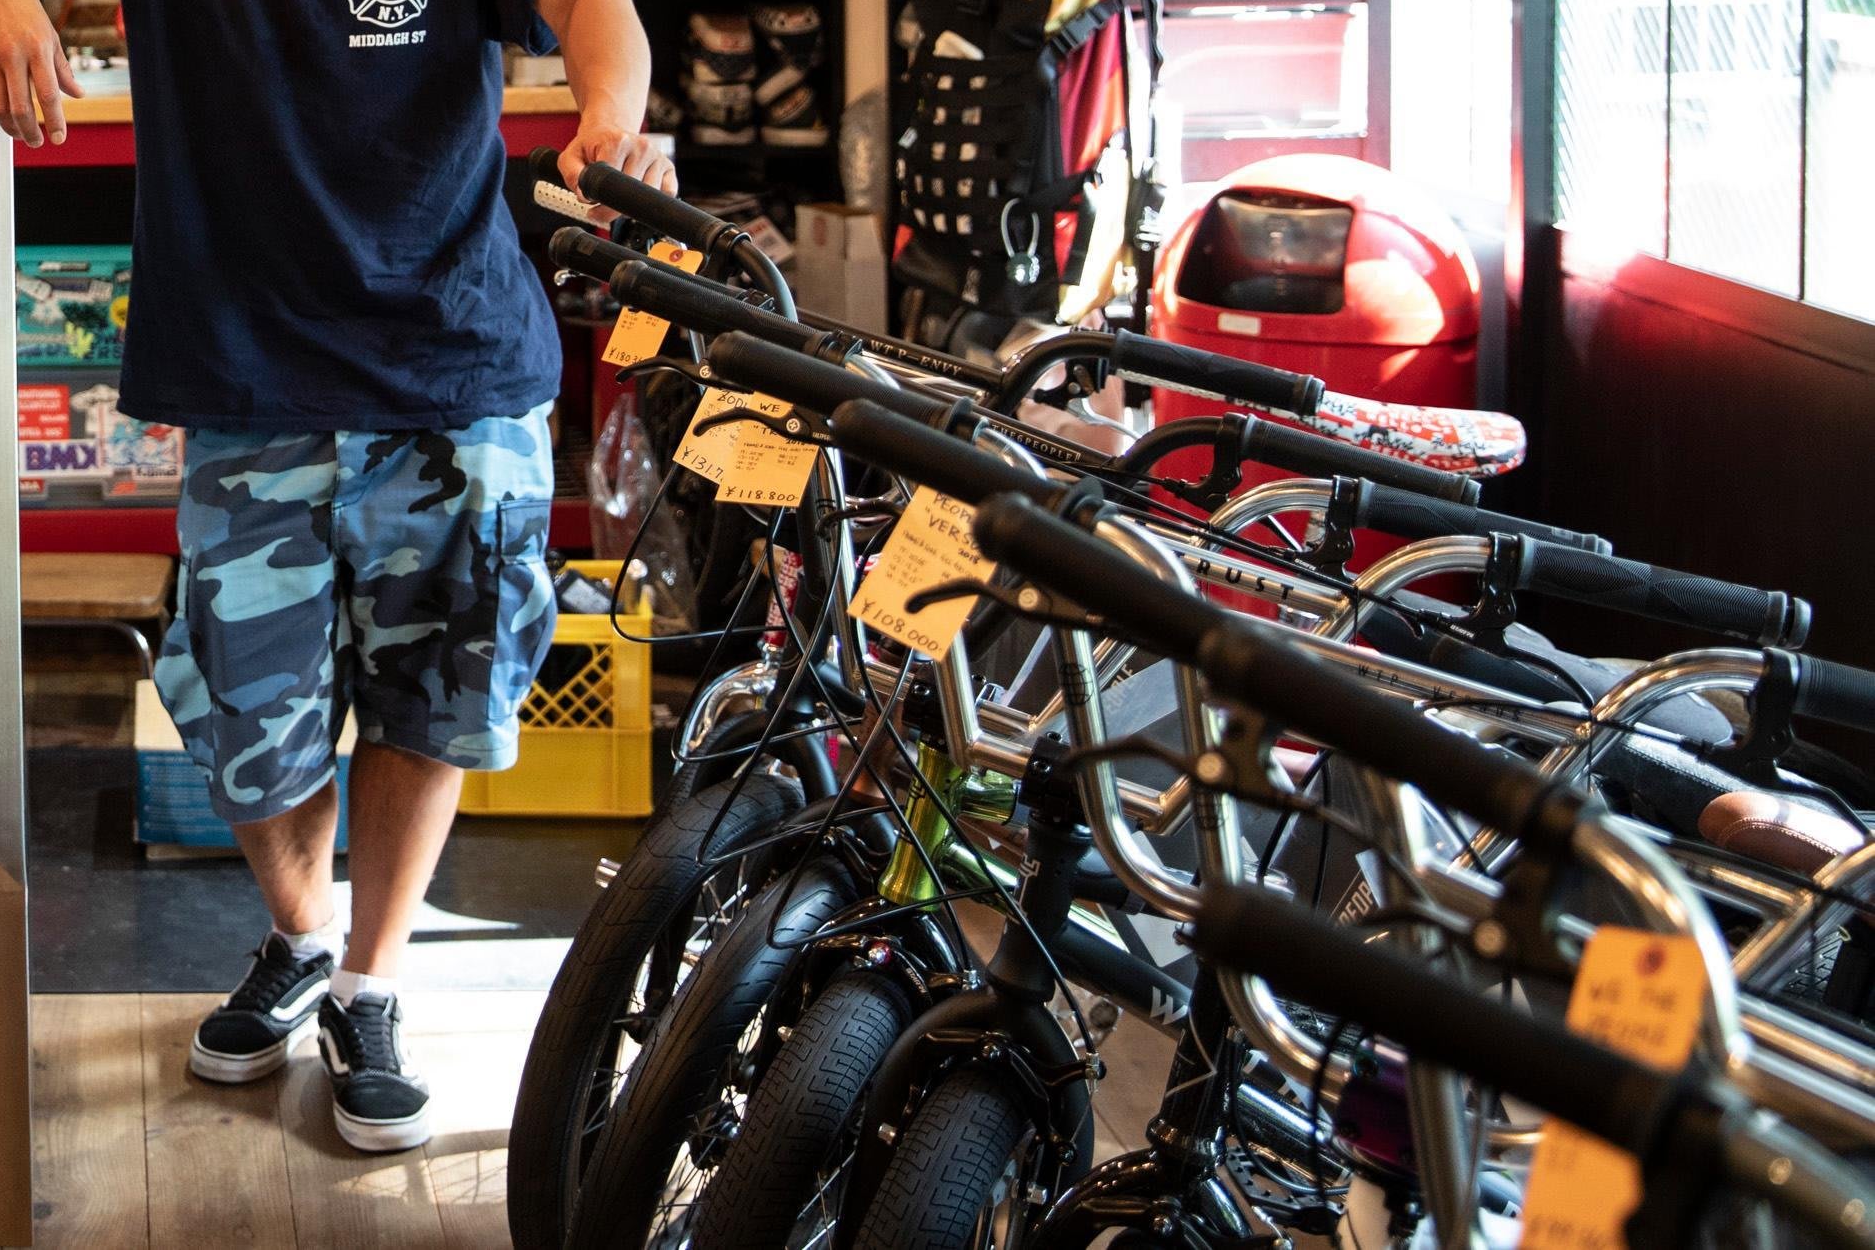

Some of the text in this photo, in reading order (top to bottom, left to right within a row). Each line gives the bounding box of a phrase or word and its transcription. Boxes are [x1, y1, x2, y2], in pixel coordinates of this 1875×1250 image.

[377, 5, 409, 22] N.Y.
[349, 30, 427, 47] MIDDAGH ST
[759, 402, 781, 414] WE
[26, 443, 97, 471] BMX
